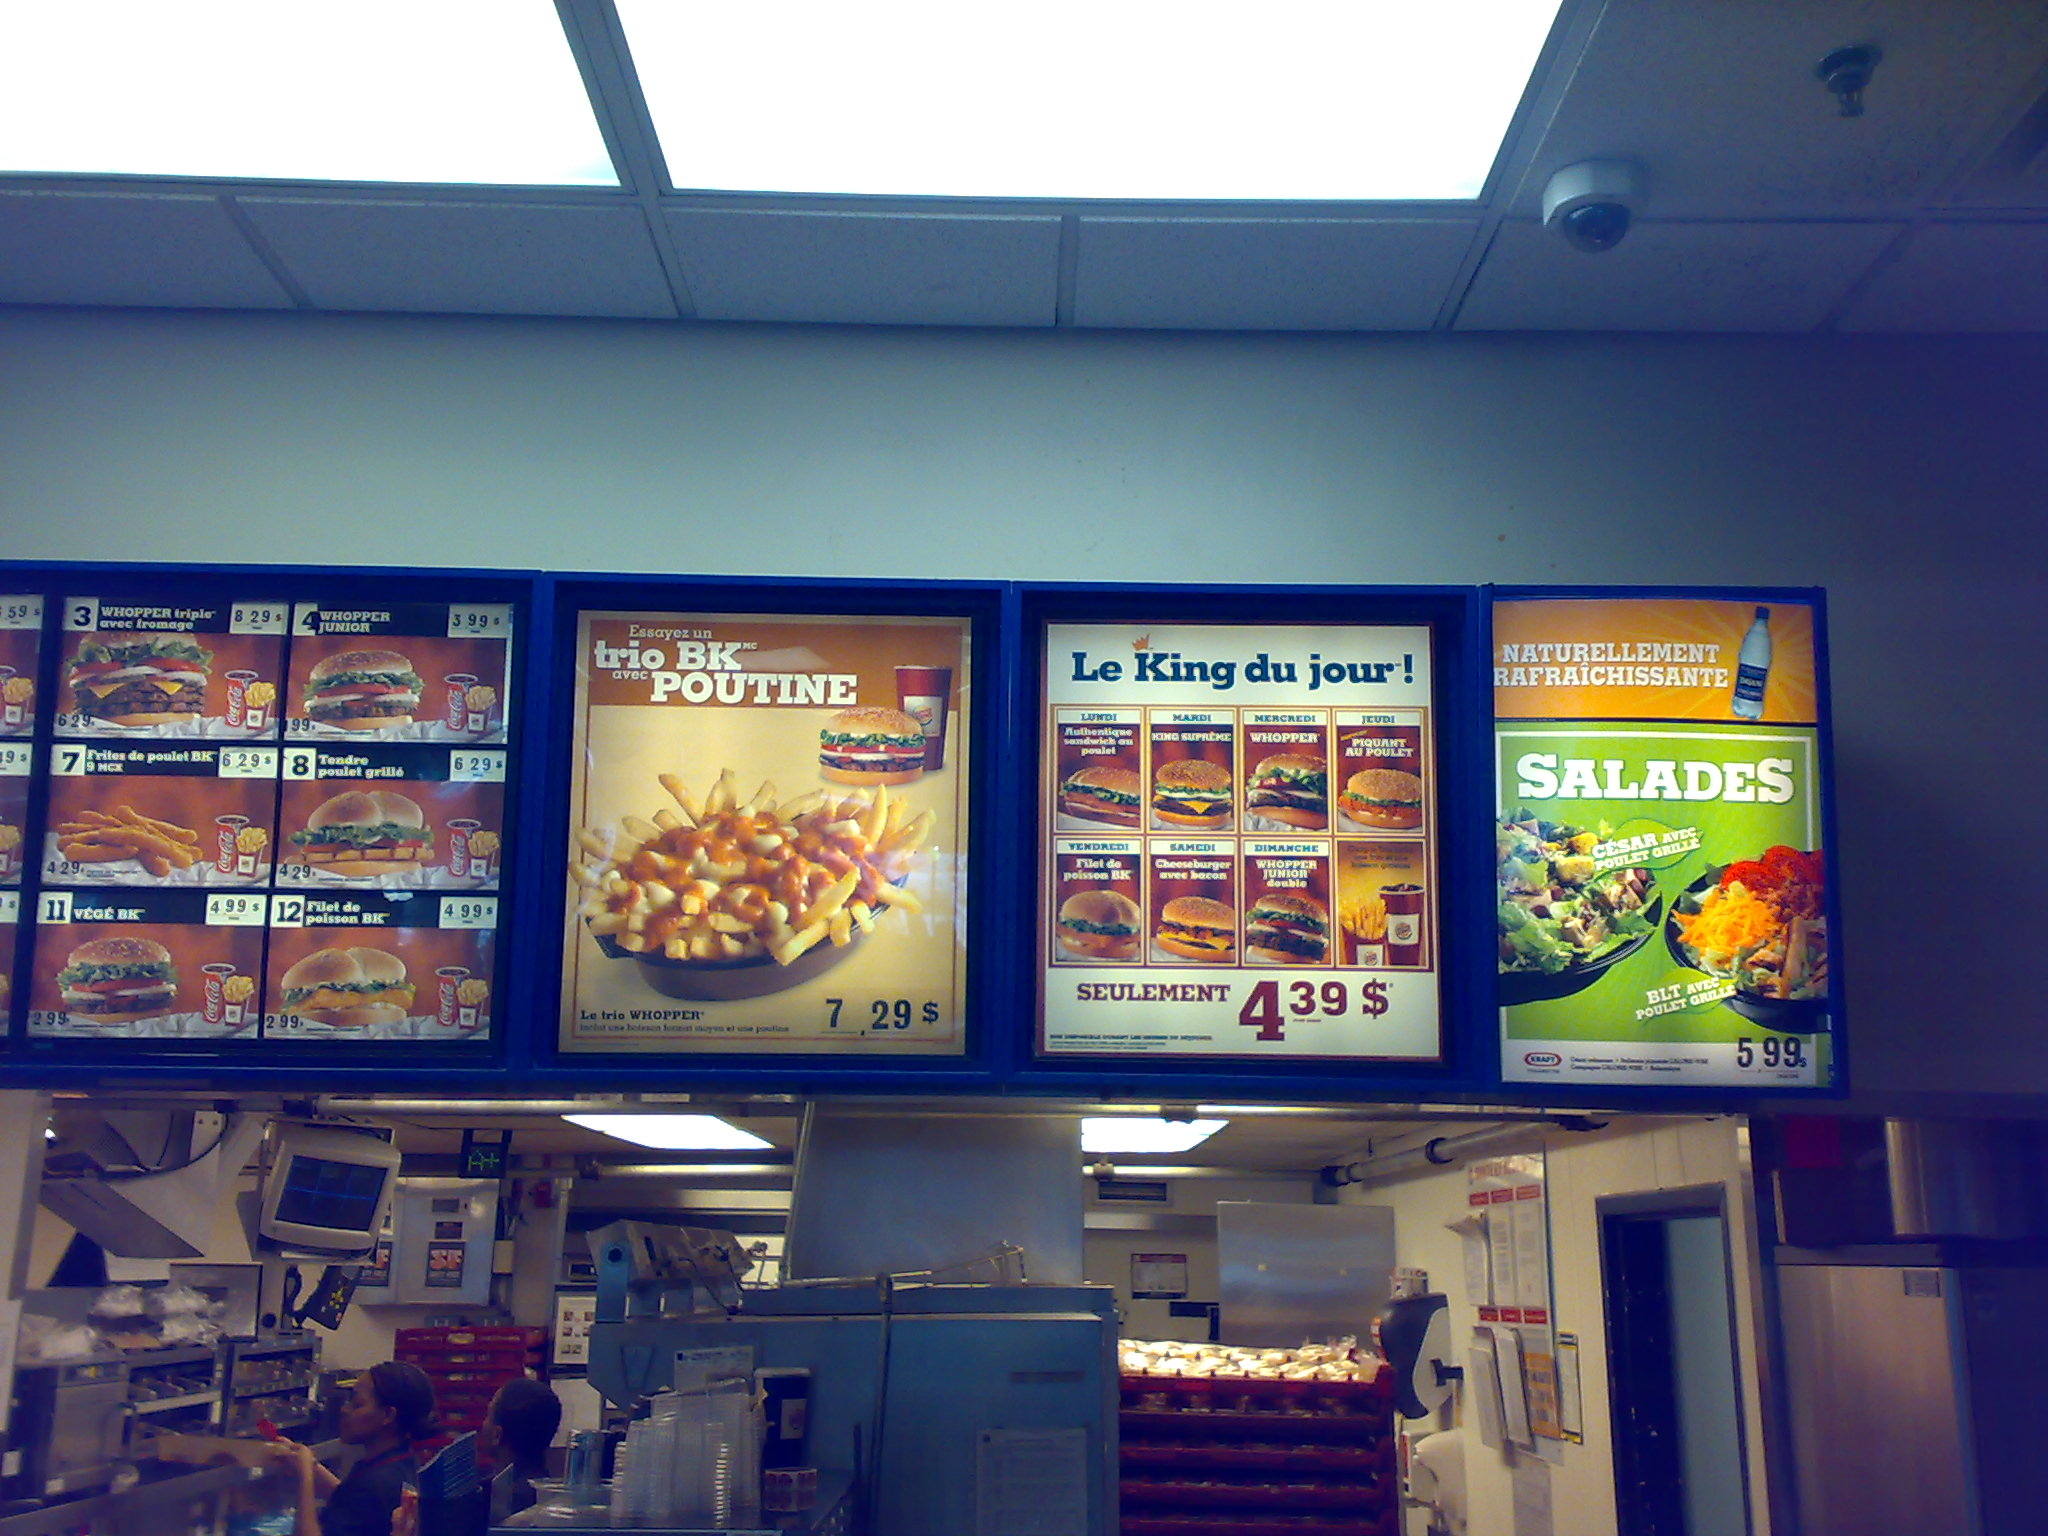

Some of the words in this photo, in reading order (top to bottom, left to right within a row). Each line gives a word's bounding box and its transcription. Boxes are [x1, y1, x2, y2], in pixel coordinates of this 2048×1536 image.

[73, 607, 91, 627] 3
[101, 606, 171, 618] WHOPPER
[174, 608, 212, 620] triple
[318, 611, 391, 623] WHOPPER
[100, 620, 133, 629] avec
[136, 618, 194, 631] fromage
[301, 610, 320, 631] 4
[317, 622, 371, 633] JUNIOR
[628, 624, 690, 640] Essayez
[693, 628, 713, 639] un
[595, 640, 666, 670] trio
[676, 641, 742, 671] BK
[1502, 642, 1720, 665] NATURELLEMENT
[1071, 651, 1123, 682] Le
[1133, 651, 1237, 690] King
[1244, 653, 1298, 684] du
[1493, 662, 1729, 689] RAFRAÎCHISSANTE
[612, 669, 648, 681] avec
[650, 671, 858, 706] POUTINE
[1081, 713, 1118, 722] LUNDI
[1173, 714, 1212, 722] MARDI
[1254, 714, 1317, 723] MERCREDI
[1361, 715, 1396, 724] JEUDI
[1064, 727, 1133, 738] Authentique
[1151, 732, 1180, 742] KING
[1250, 732, 1319, 744] WHOPPER
[1064, 737, 1116, 746] sandwich
[1117, 738, 1134, 746] au
[1351, 738, 1408, 748] PIQUANT
[87, 749, 126, 762] Frites
[127, 750, 145, 762] de
[147, 751, 189, 764] poulet
[190, 751, 215, 762] BK
[1081, 746, 1117, 757] poulet
[1345, 747, 1363, 757] AU
[1365, 748, 1414, 758] POULET
[62, 752, 80, 772] 7
[291, 754, 310, 776] 8
[318, 754, 369, 765] Tendre
[86, 761, 95, 772] 9
[318, 766, 362, 778] poulet
[365, 765, 404, 779] grillé
[1515, 751, 1795, 805] SALADES
[1068, 843, 1130, 852] VENDREDI
[1169, 843, 1216, 852] SAMEDI
[1254, 844, 1320, 853] DIMANCHE
[1591, 832, 1659, 859] CÉSAR
[1662, 826, 1697, 843] AVEC
[1076, 858, 1104, 869] Filet
[1105, 858, 1122, 869] de
[1154, 858, 1232, 870] Cheeseburger
[1256, 859, 1318, 870] WHOPPER
[1594, 850, 1650, 871] POULET
[1063, 870, 1109, 881] poisson
[1111, 870, 1131, 880] BK
[1159, 871, 1188, 880] avec
[1190, 870, 1227, 881] bacon
[1262, 869, 1309, 880] JUNIOR
[1266, 878, 1308, 888] double
[46, 899, 66, 921] 11
[276, 901, 302, 923] 12
[306, 900, 341, 912] Filet
[343, 901, 361, 912] de
[74, 906, 114, 920] VÉGÉ
[117, 908, 140, 920] BK
[305, 913, 359, 927] poisson
[362, 912, 385, 924] BK
[1646, 984, 1682, 1005] BLT
[1687, 977, 1720, 995] AVEC
[1077, 982, 1232, 1002] SEULEMENT
[1361, 977, 1391, 1020] $
[922, 1000, 940, 1026] $
[1636, 998, 1688, 1020] POULET
[580, 1010, 597, 1020] Le
[601, 1010, 625, 1020] trio
[629, 1010, 701, 1021] WHOPPER
[1530, 1055, 1555, 1064] KRAFT
